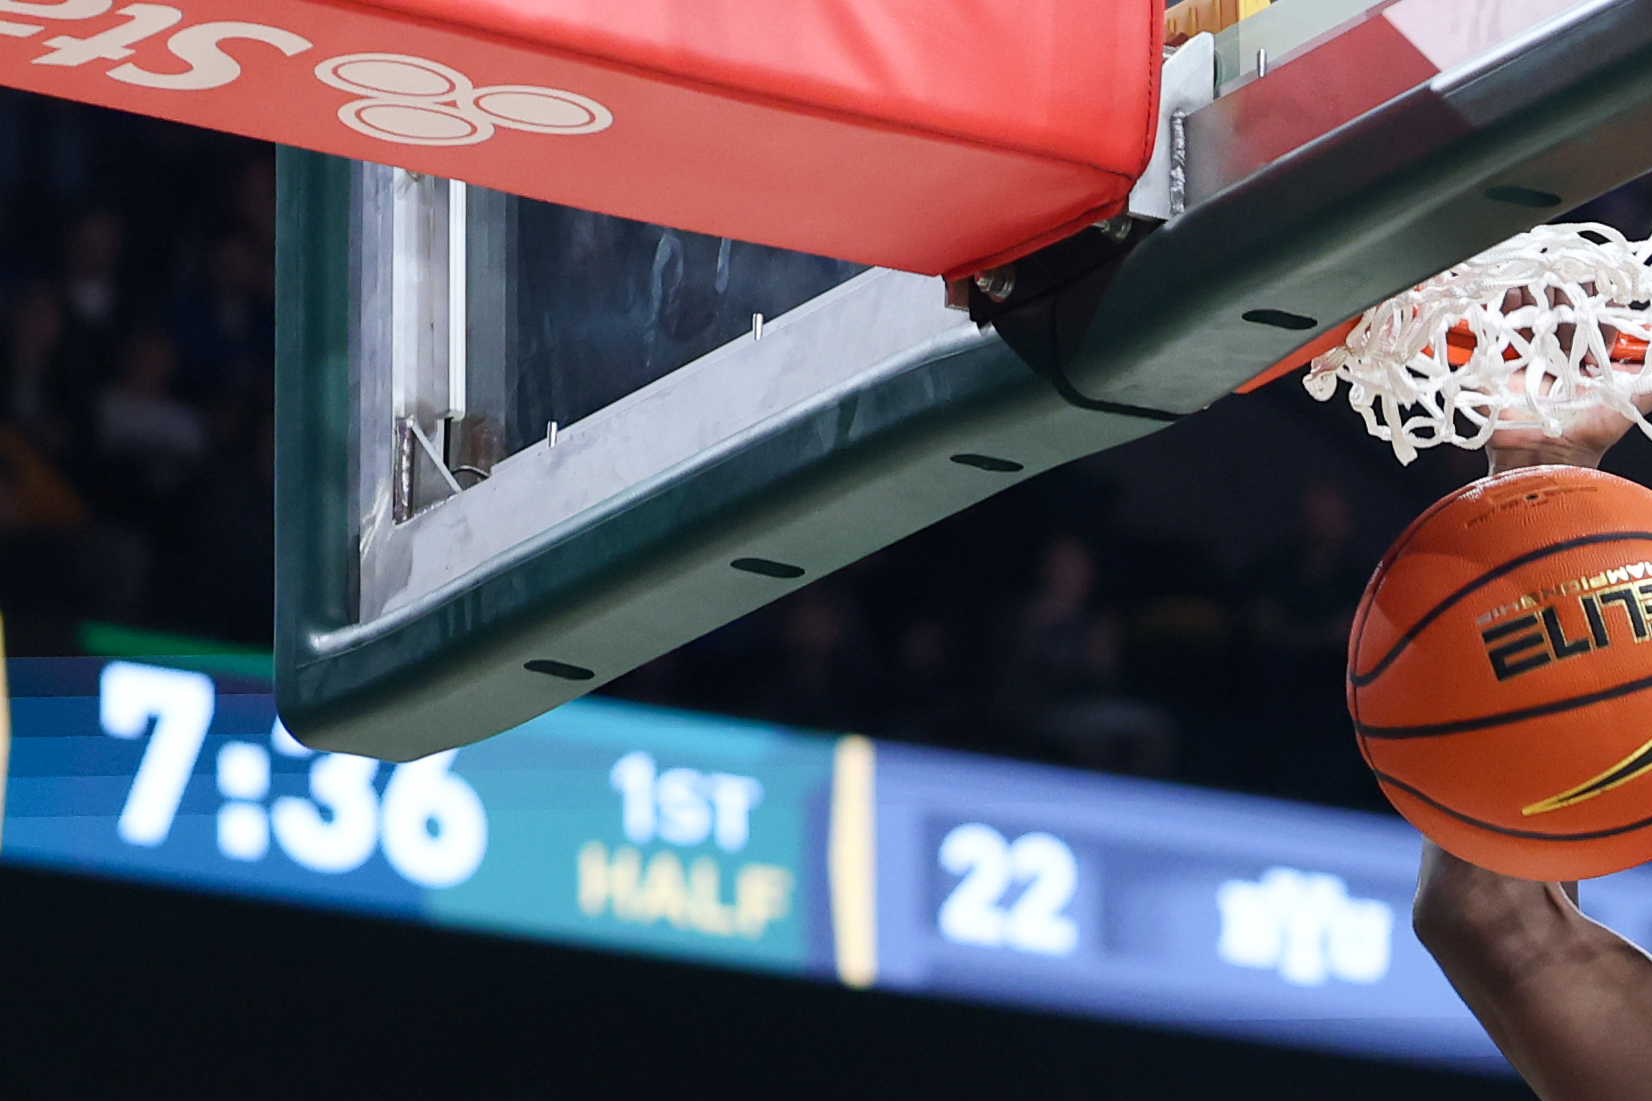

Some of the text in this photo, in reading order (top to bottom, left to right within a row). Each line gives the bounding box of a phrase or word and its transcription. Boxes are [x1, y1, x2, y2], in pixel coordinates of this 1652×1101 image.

[99, 659, 488, 888] 7:36
[609, 750, 763, 853] 1ST
[576, 840, 794, 939] HALF
[938, 821, 1079, 957] 22
